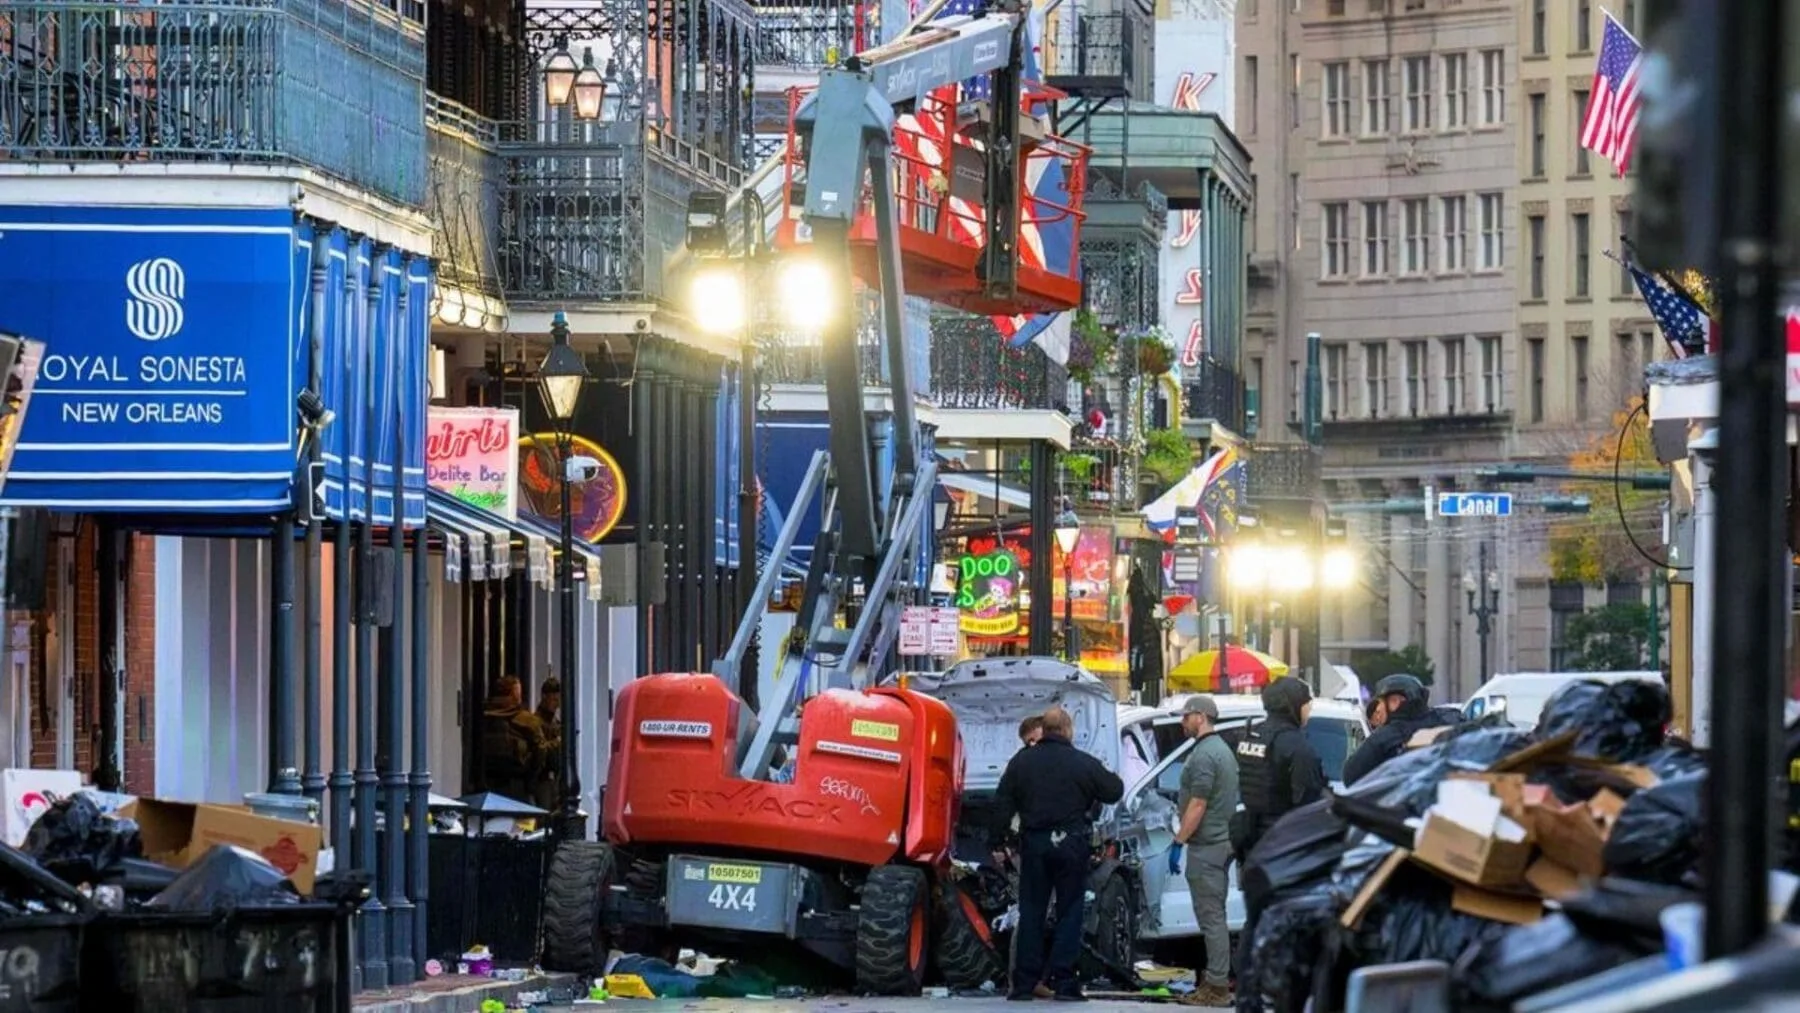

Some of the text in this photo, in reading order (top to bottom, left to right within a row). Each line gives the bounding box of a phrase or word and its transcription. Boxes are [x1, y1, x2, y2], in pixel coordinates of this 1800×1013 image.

[36, 356, 246, 382] OYAL SONESTA
[62, 403, 222, 423] NEW ORLEANS
[427, 465, 507, 482] Delite Bar
[1458, 495, 1498, 515] Canal
[962, 554, 1010, 581] DOO
[710, 867, 760, 880] 10507501
[708, 884, 757, 912] 4X4
